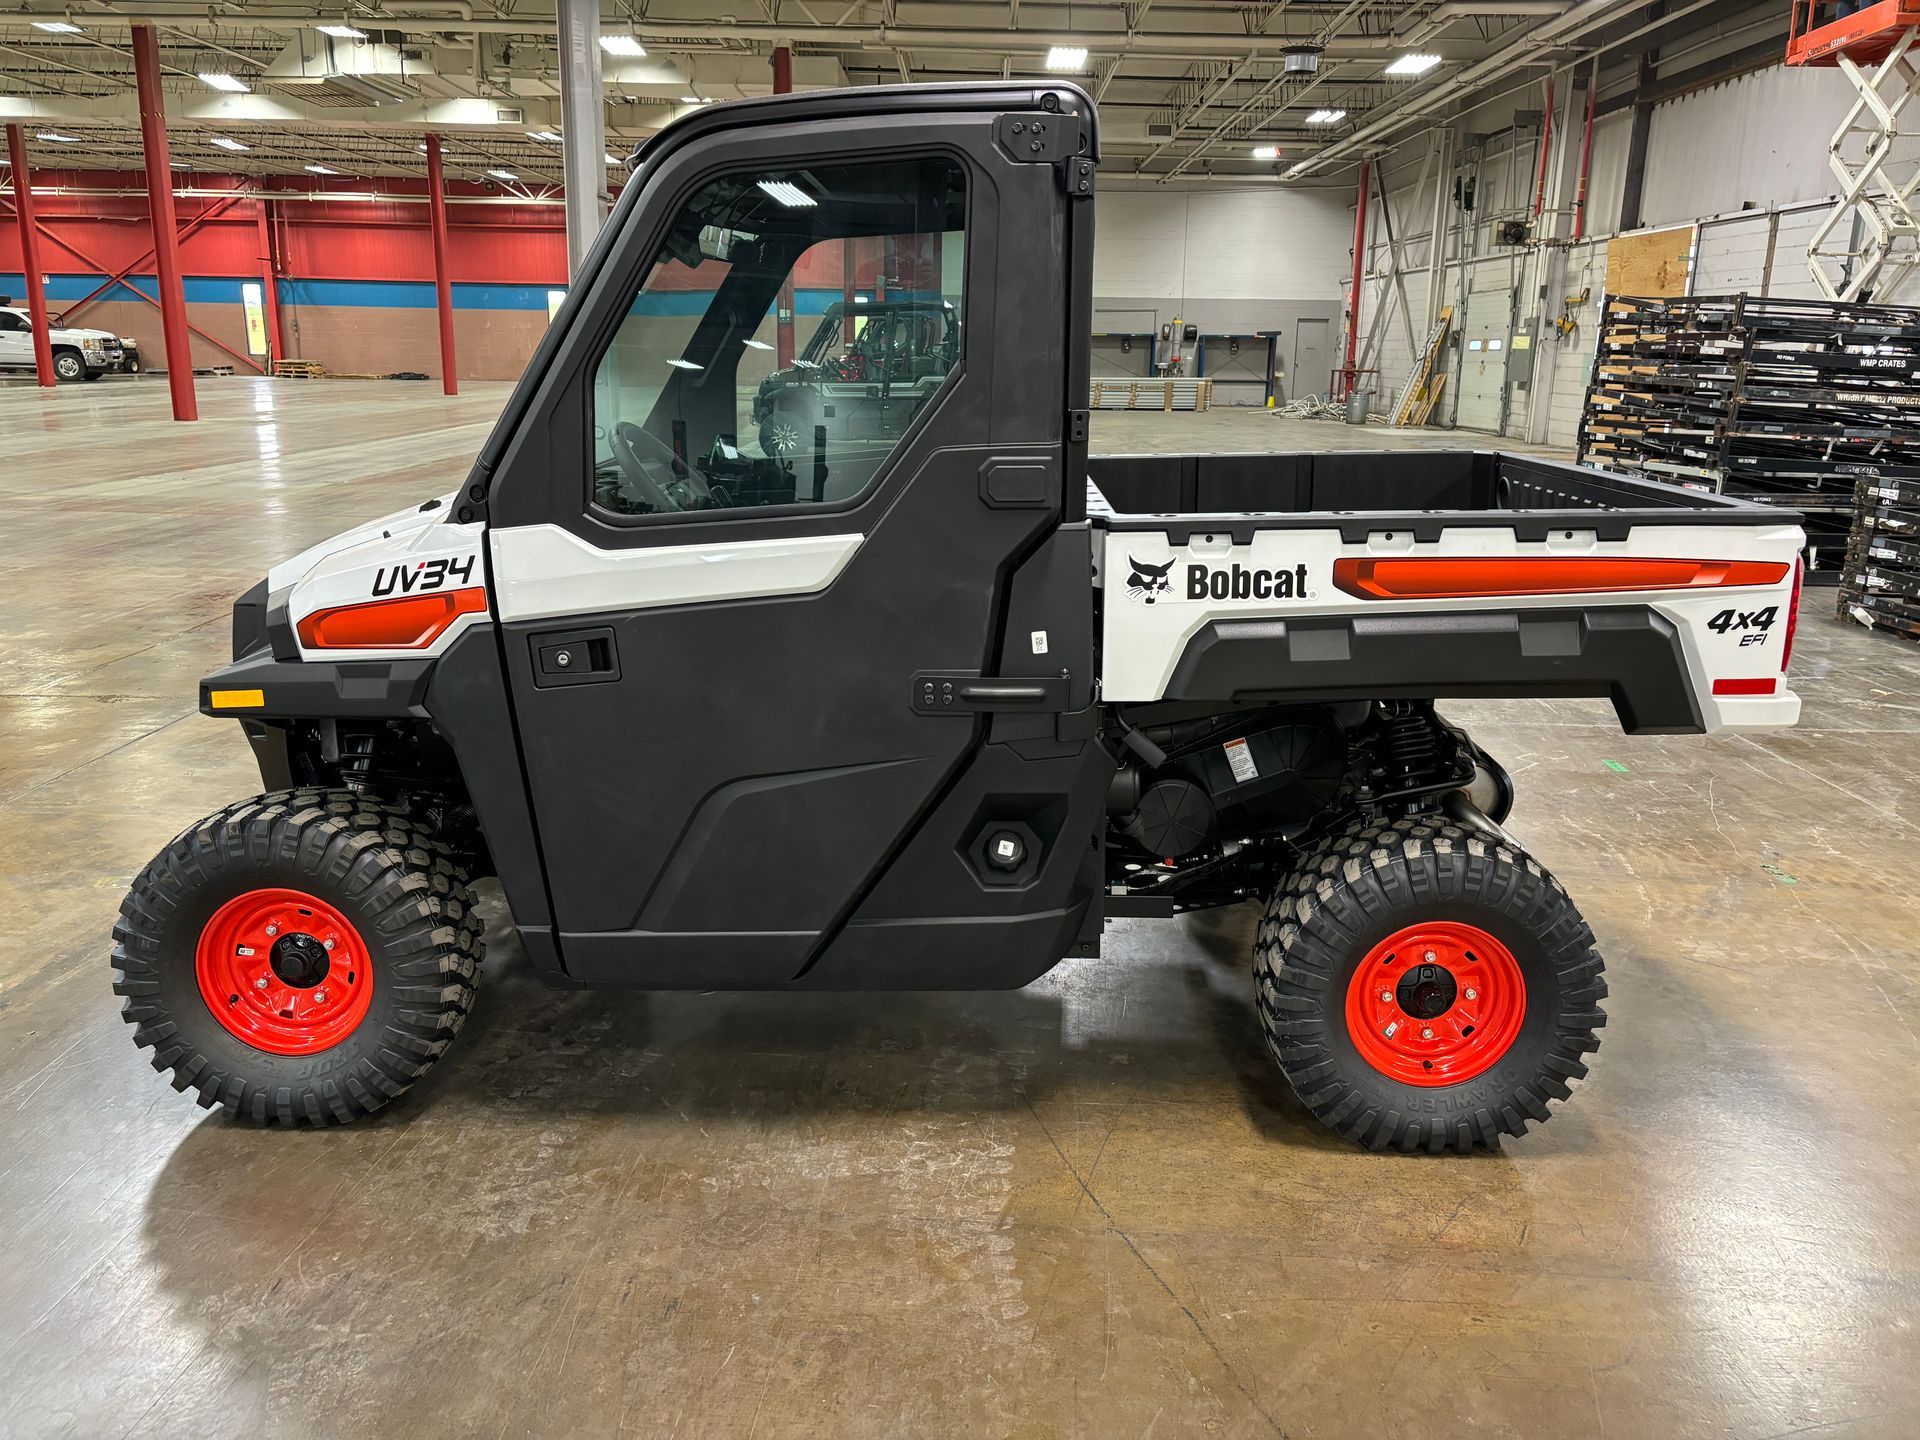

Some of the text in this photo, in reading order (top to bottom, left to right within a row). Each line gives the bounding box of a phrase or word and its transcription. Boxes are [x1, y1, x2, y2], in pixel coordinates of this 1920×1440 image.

[1860, 358, 1906, 368] WMP CRATES
[371, 555, 476, 597] UV34
[1187, 563, 1308, 600] Bobcat
[1707, 606, 1779, 634] 4x4
[1739, 633, 1768, 647] EFI
[1406, 1069, 1519, 1114] CRAWLER
